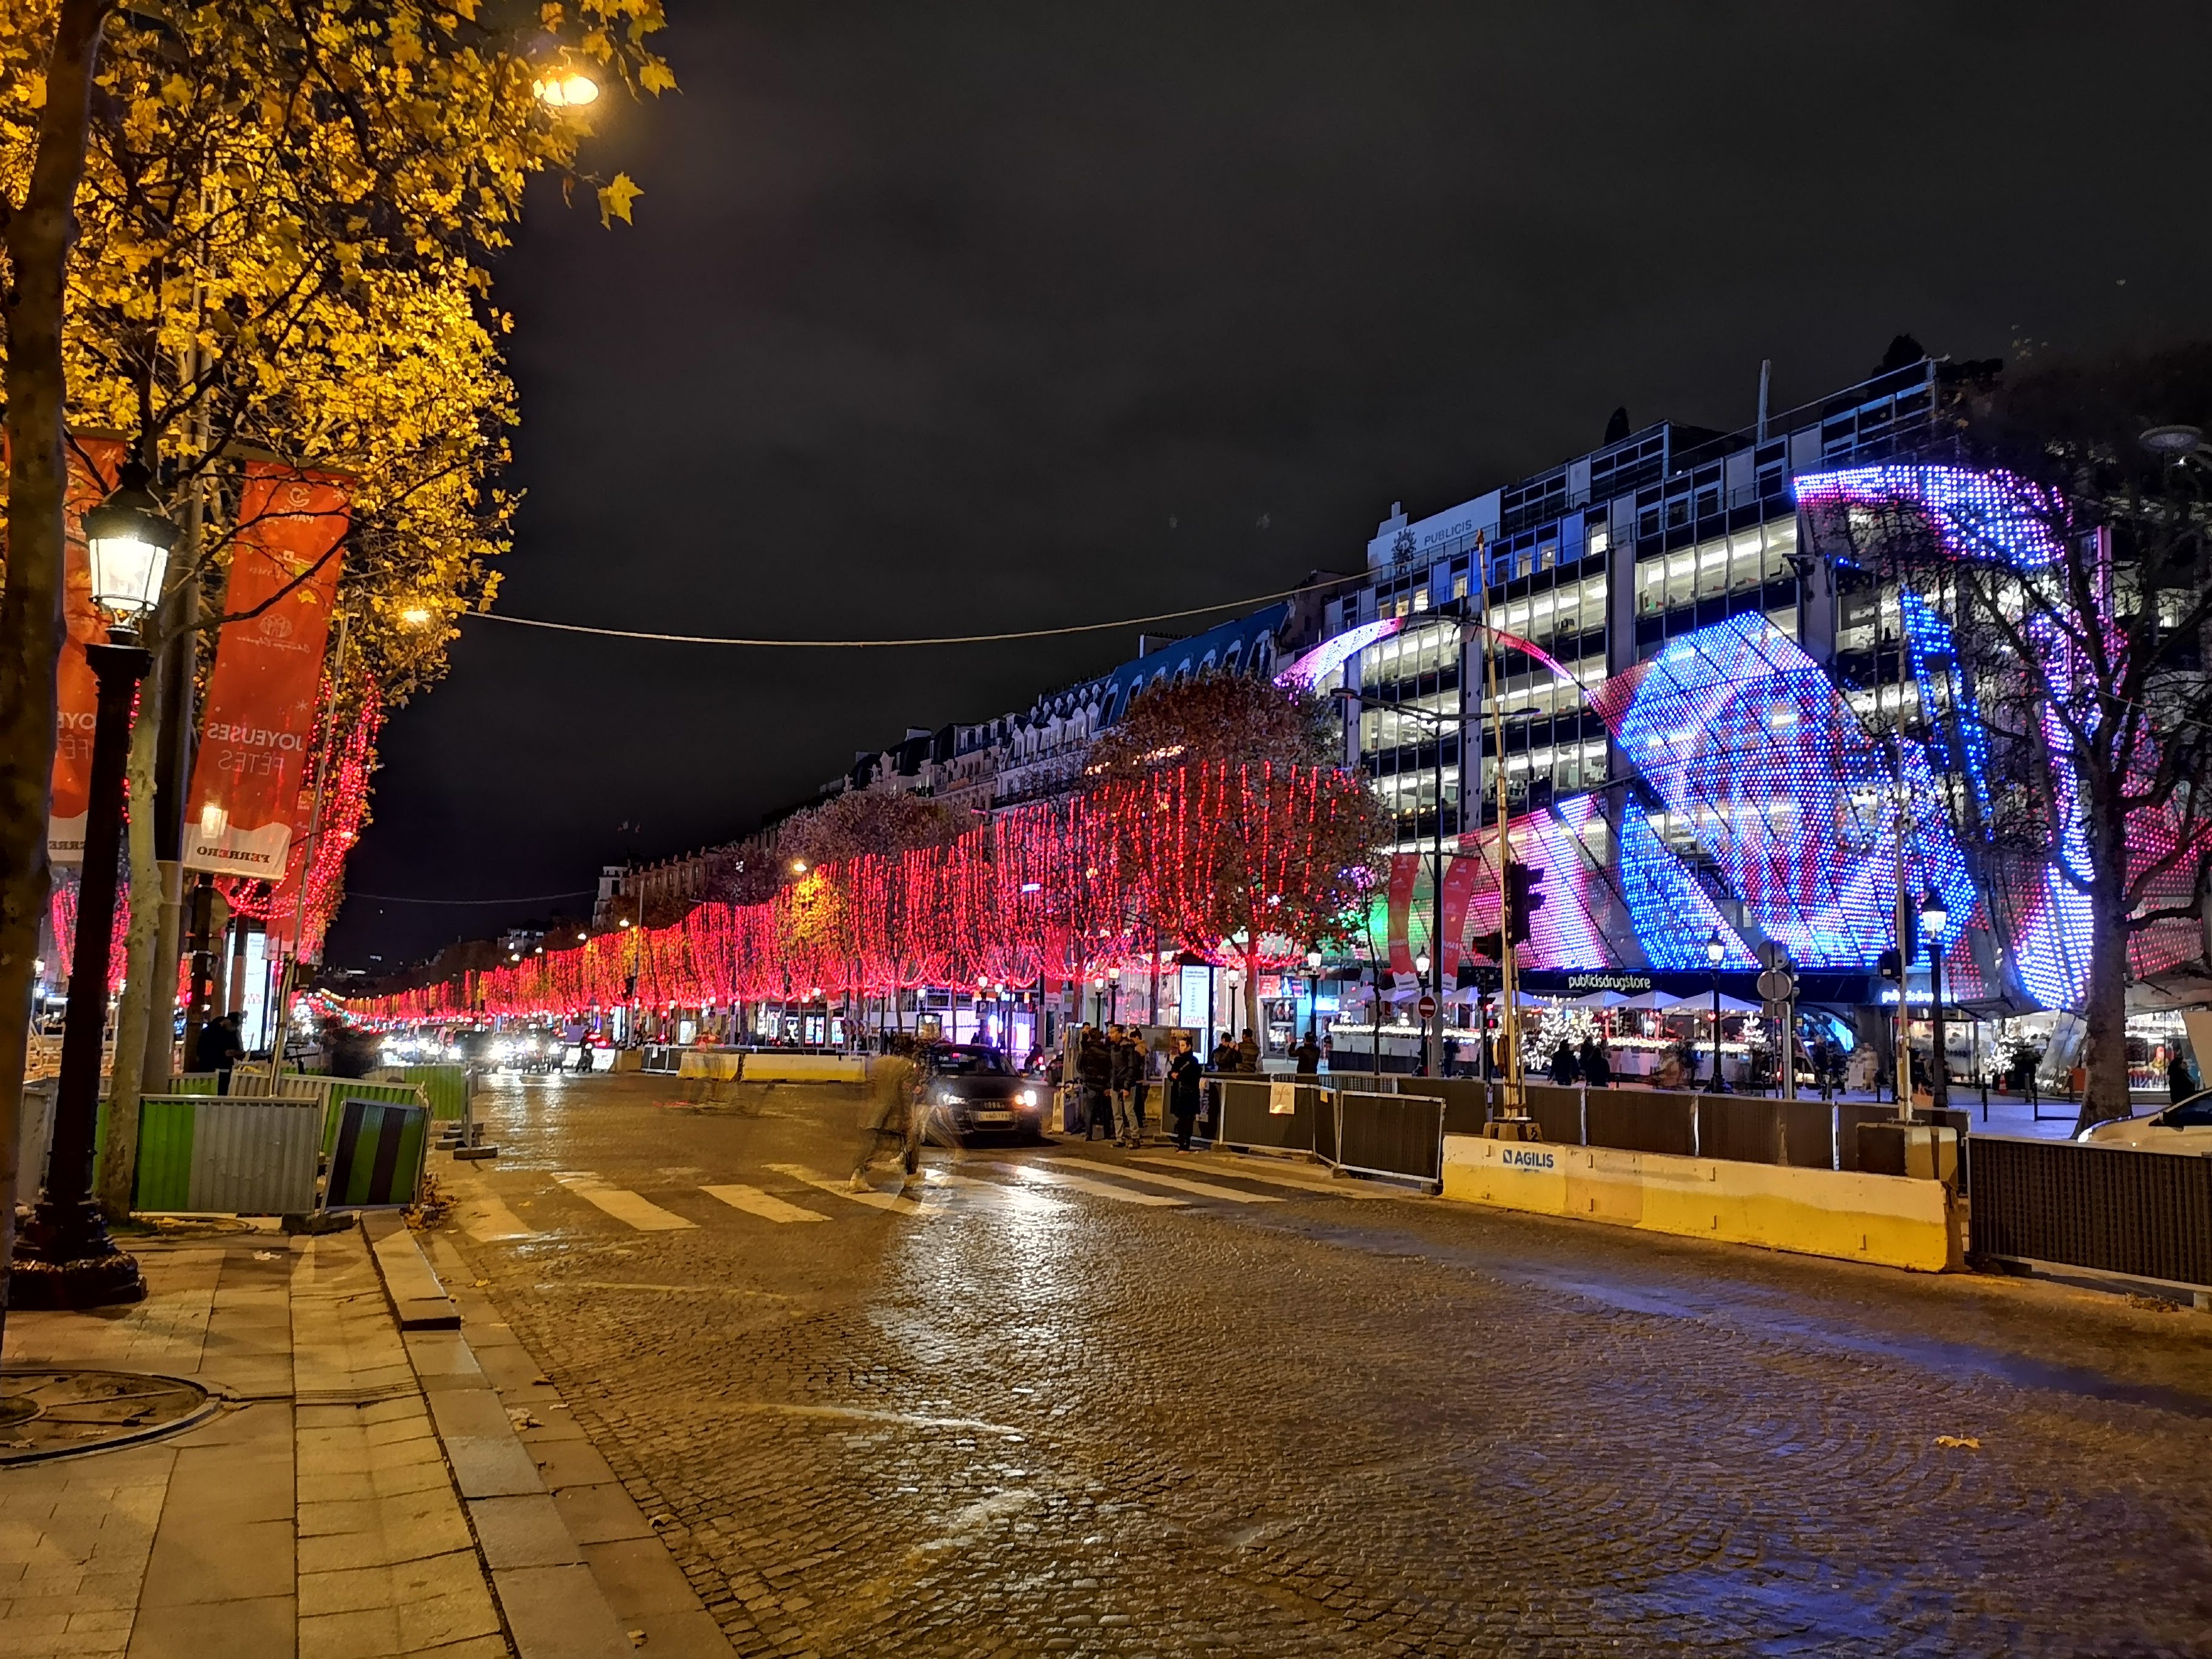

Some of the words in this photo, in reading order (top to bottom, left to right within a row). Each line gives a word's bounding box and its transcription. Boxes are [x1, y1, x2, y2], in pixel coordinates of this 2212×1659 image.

[1424, 519, 1472, 546] PUBLICIS
[1568, 974, 1651, 991] publicisdrugstore
[1514, 1150, 1554, 1168] AGILIS
